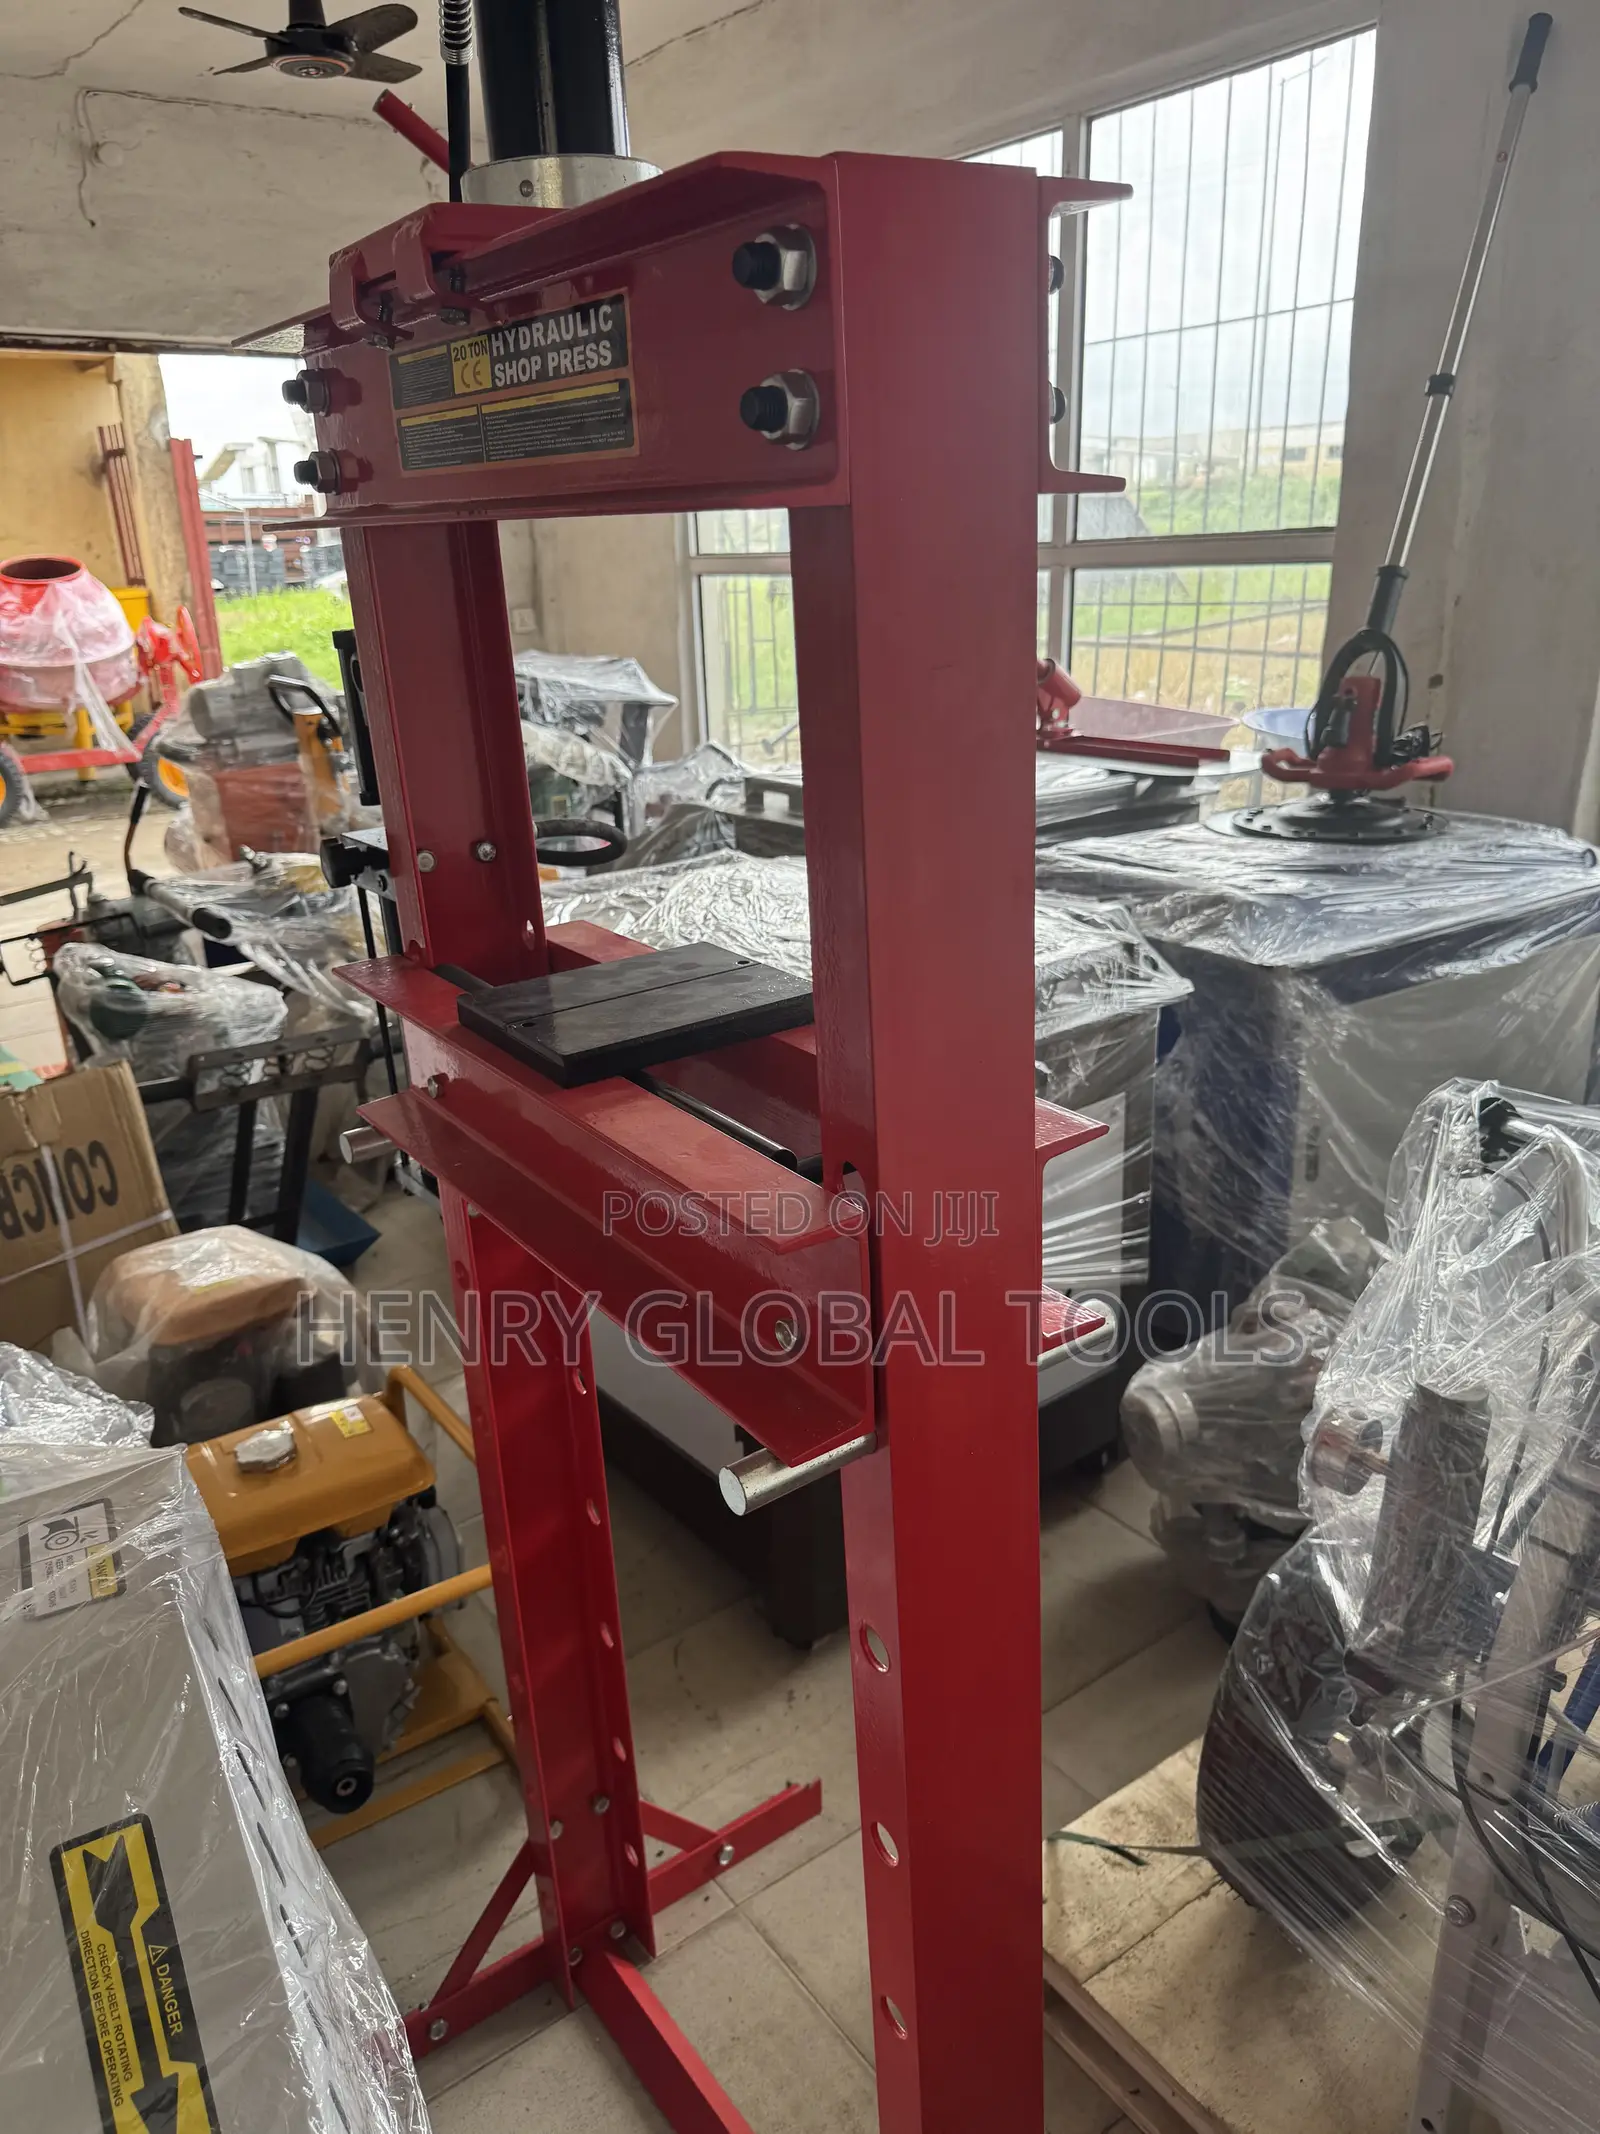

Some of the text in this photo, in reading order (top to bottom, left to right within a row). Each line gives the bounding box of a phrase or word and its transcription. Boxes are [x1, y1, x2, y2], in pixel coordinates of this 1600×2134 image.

[452, 338, 489, 363] 20 TON
[490, 304, 613, 357] HYDRAULIC
[494, 340, 613, 388] SHOP PRESS
[80, 1930, 124, 2107] DIRECTION BEFORE OPERATING
[97, 1943, 133, 2082] CHECK V-BELT ROTATING
[155, 1963, 184, 2036] DANGER
